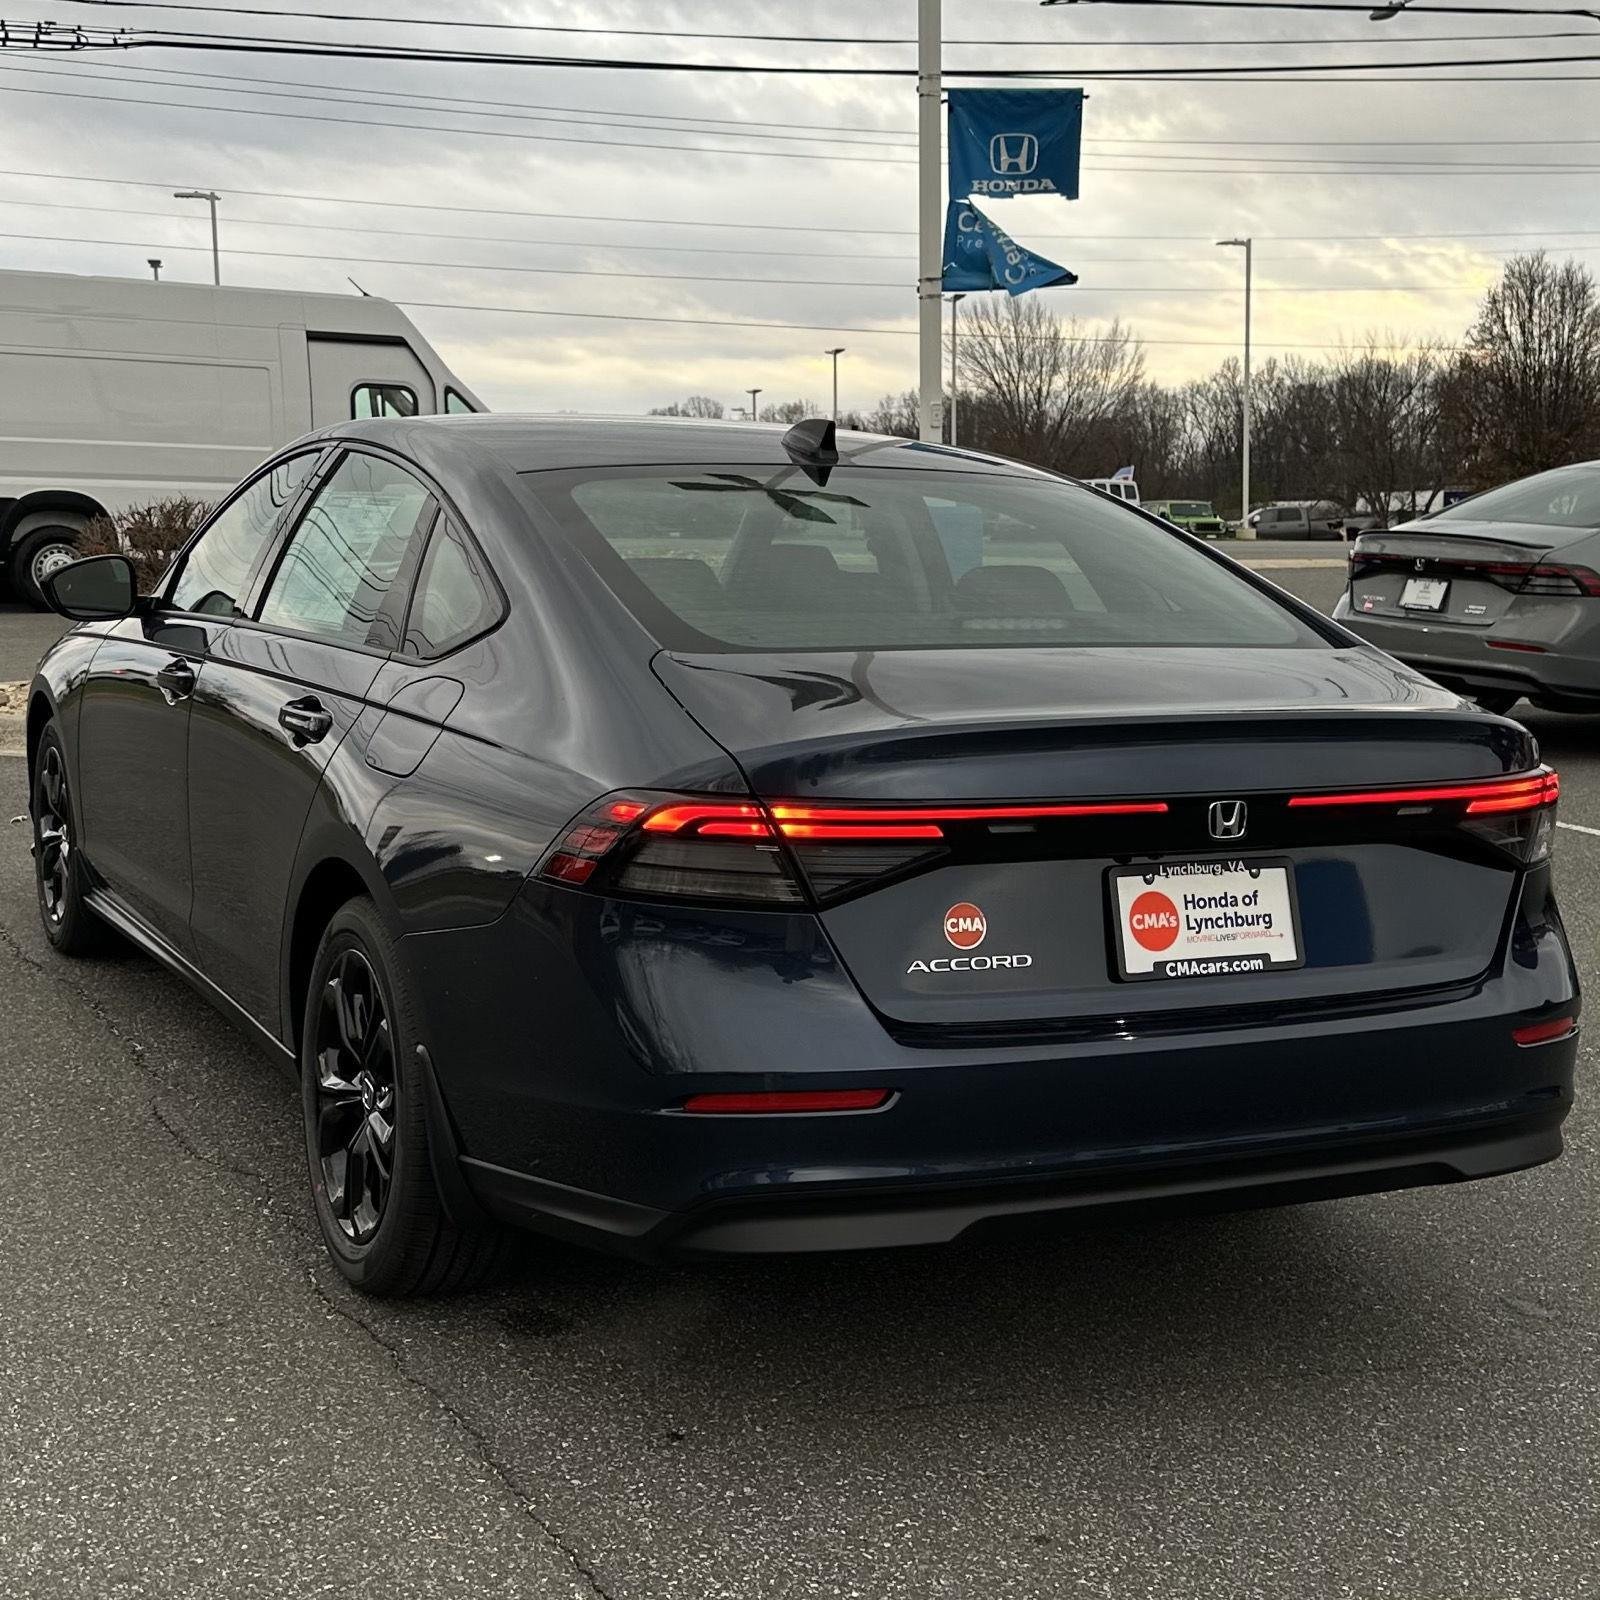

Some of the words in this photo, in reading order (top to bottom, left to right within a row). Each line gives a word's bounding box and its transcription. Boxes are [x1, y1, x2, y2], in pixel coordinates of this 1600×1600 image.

[971, 179, 1056, 192] HONDA
[1159, 862, 1225, 877] Lynchburg,
[1228, 861, 1246, 873] VA
[1183, 892, 1239, 910] Honda
[1242, 890, 1259, 907] of
[946, 917, 983, 933] CMA
[1132, 912, 1178, 930] CMA's
[1186, 912, 1273, 934] Lynchburg
[907, 954, 1032, 974] ACCORD
[1166, 958, 1264, 978] CMAcars.com
